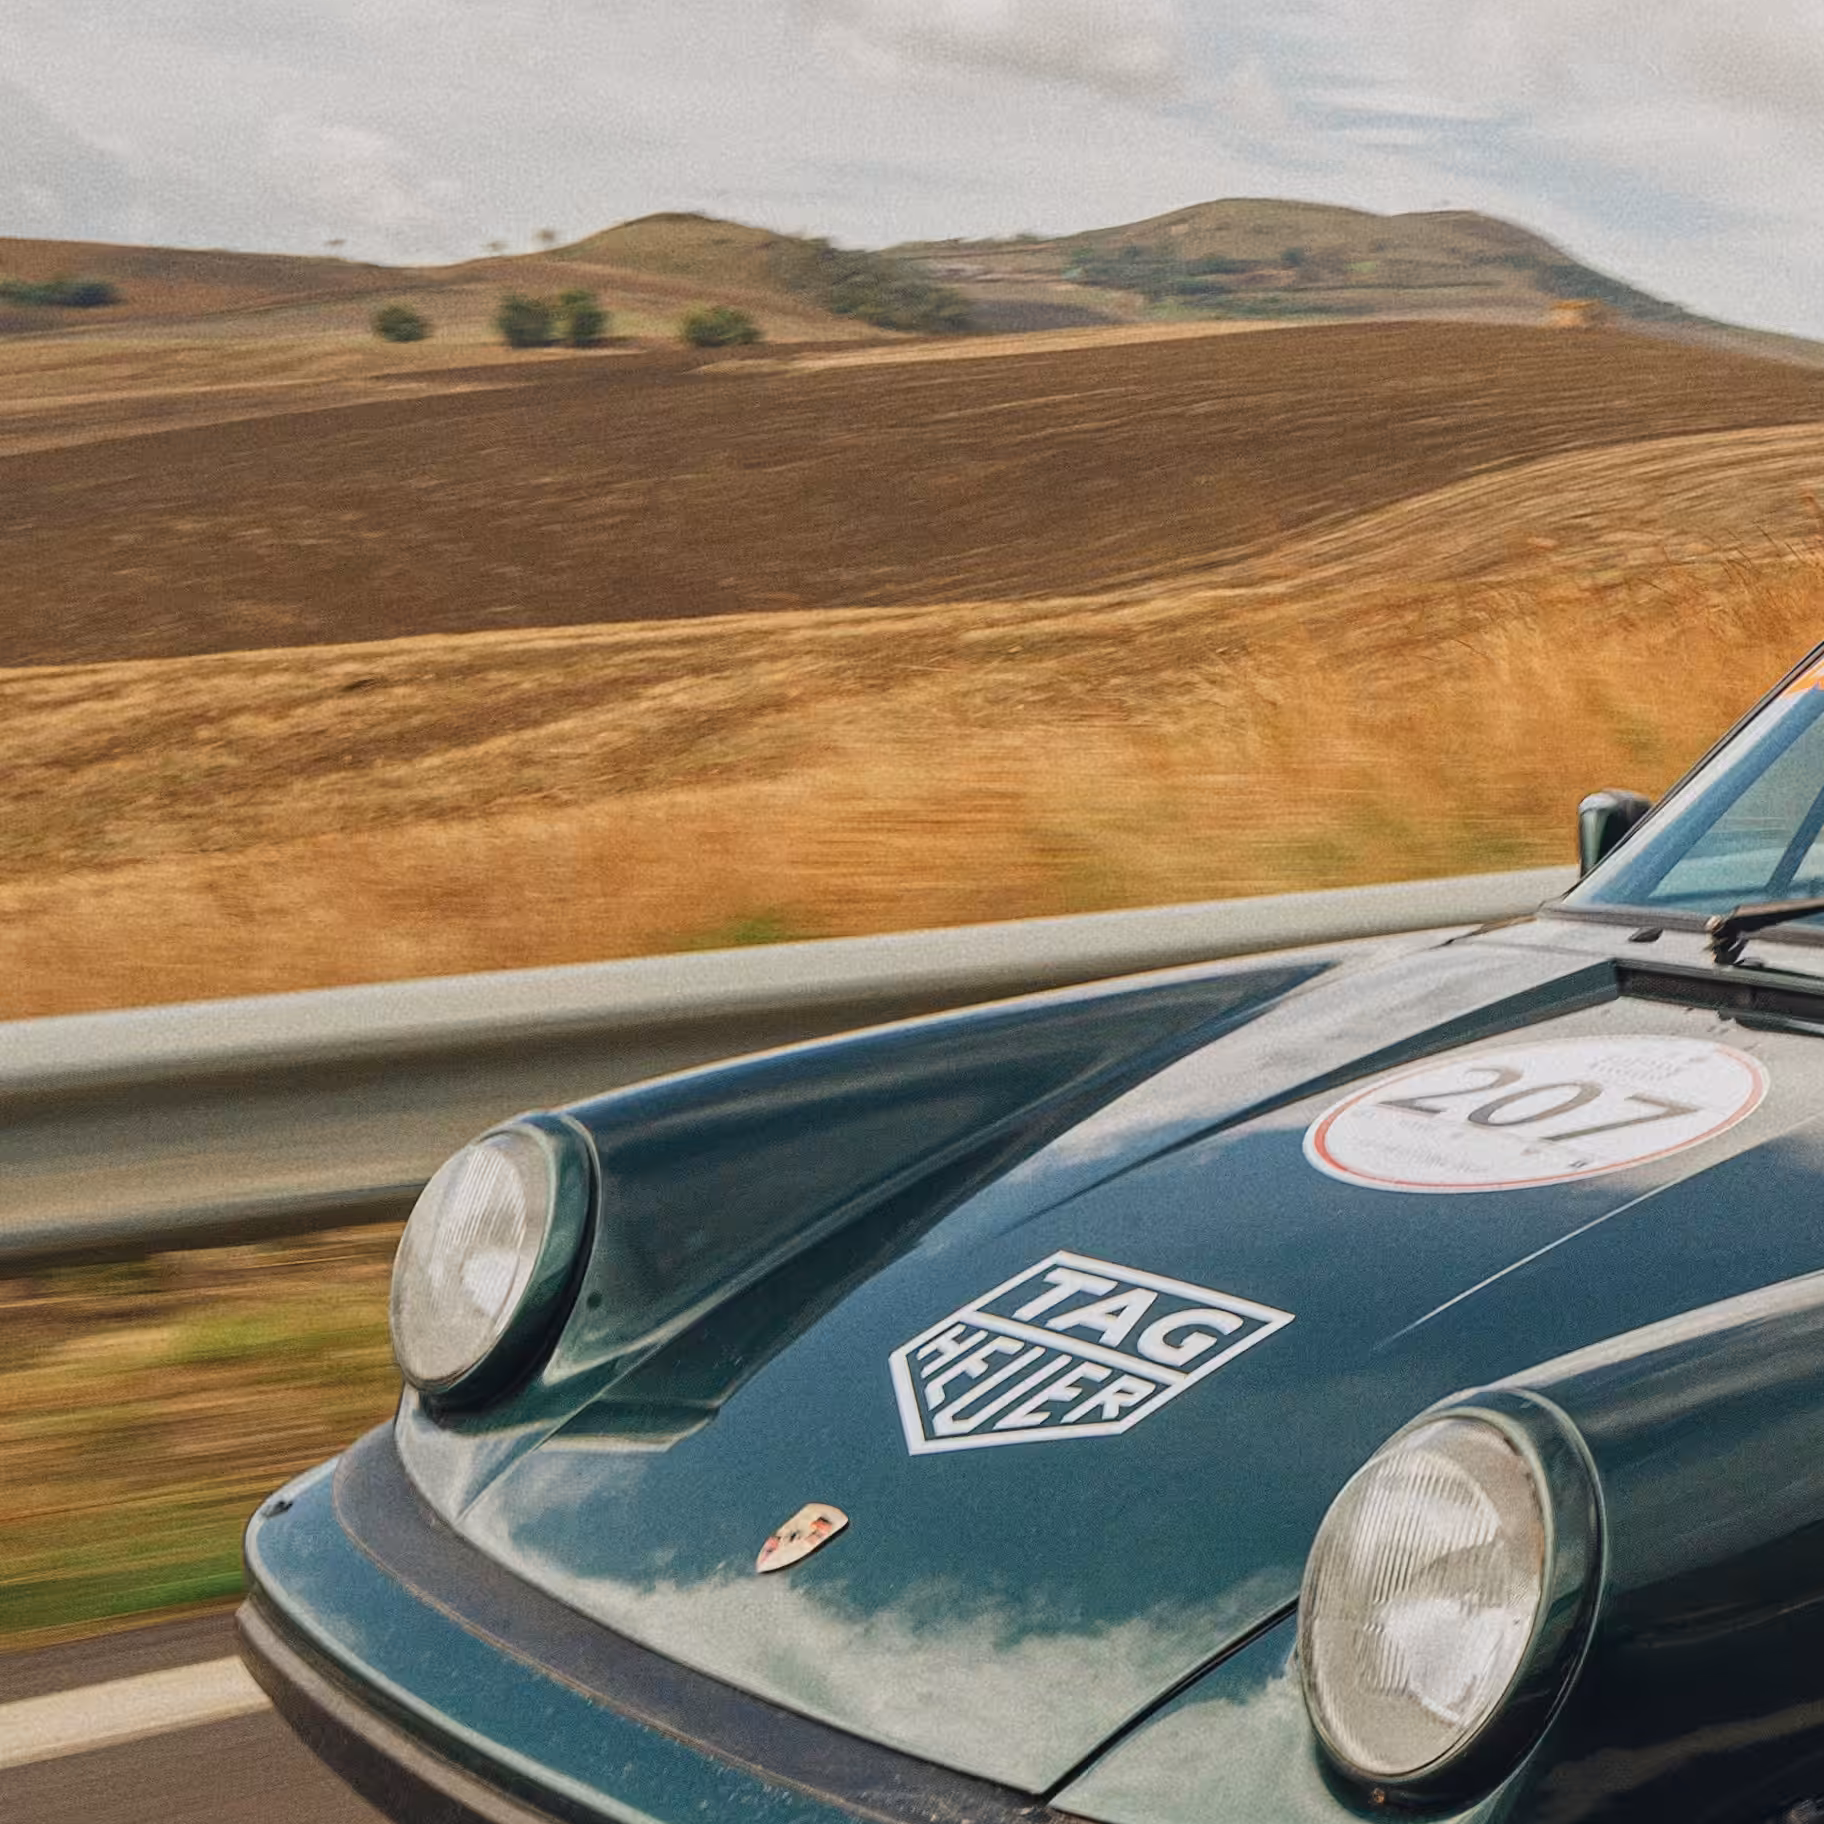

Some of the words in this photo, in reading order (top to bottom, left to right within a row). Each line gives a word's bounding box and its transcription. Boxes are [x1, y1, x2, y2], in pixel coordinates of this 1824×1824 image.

[1376, 1066, 1701, 1143] 207
[1012, 1267, 1244, 1367] TAG
[915, 1323, 1156, 1436] HEUER
